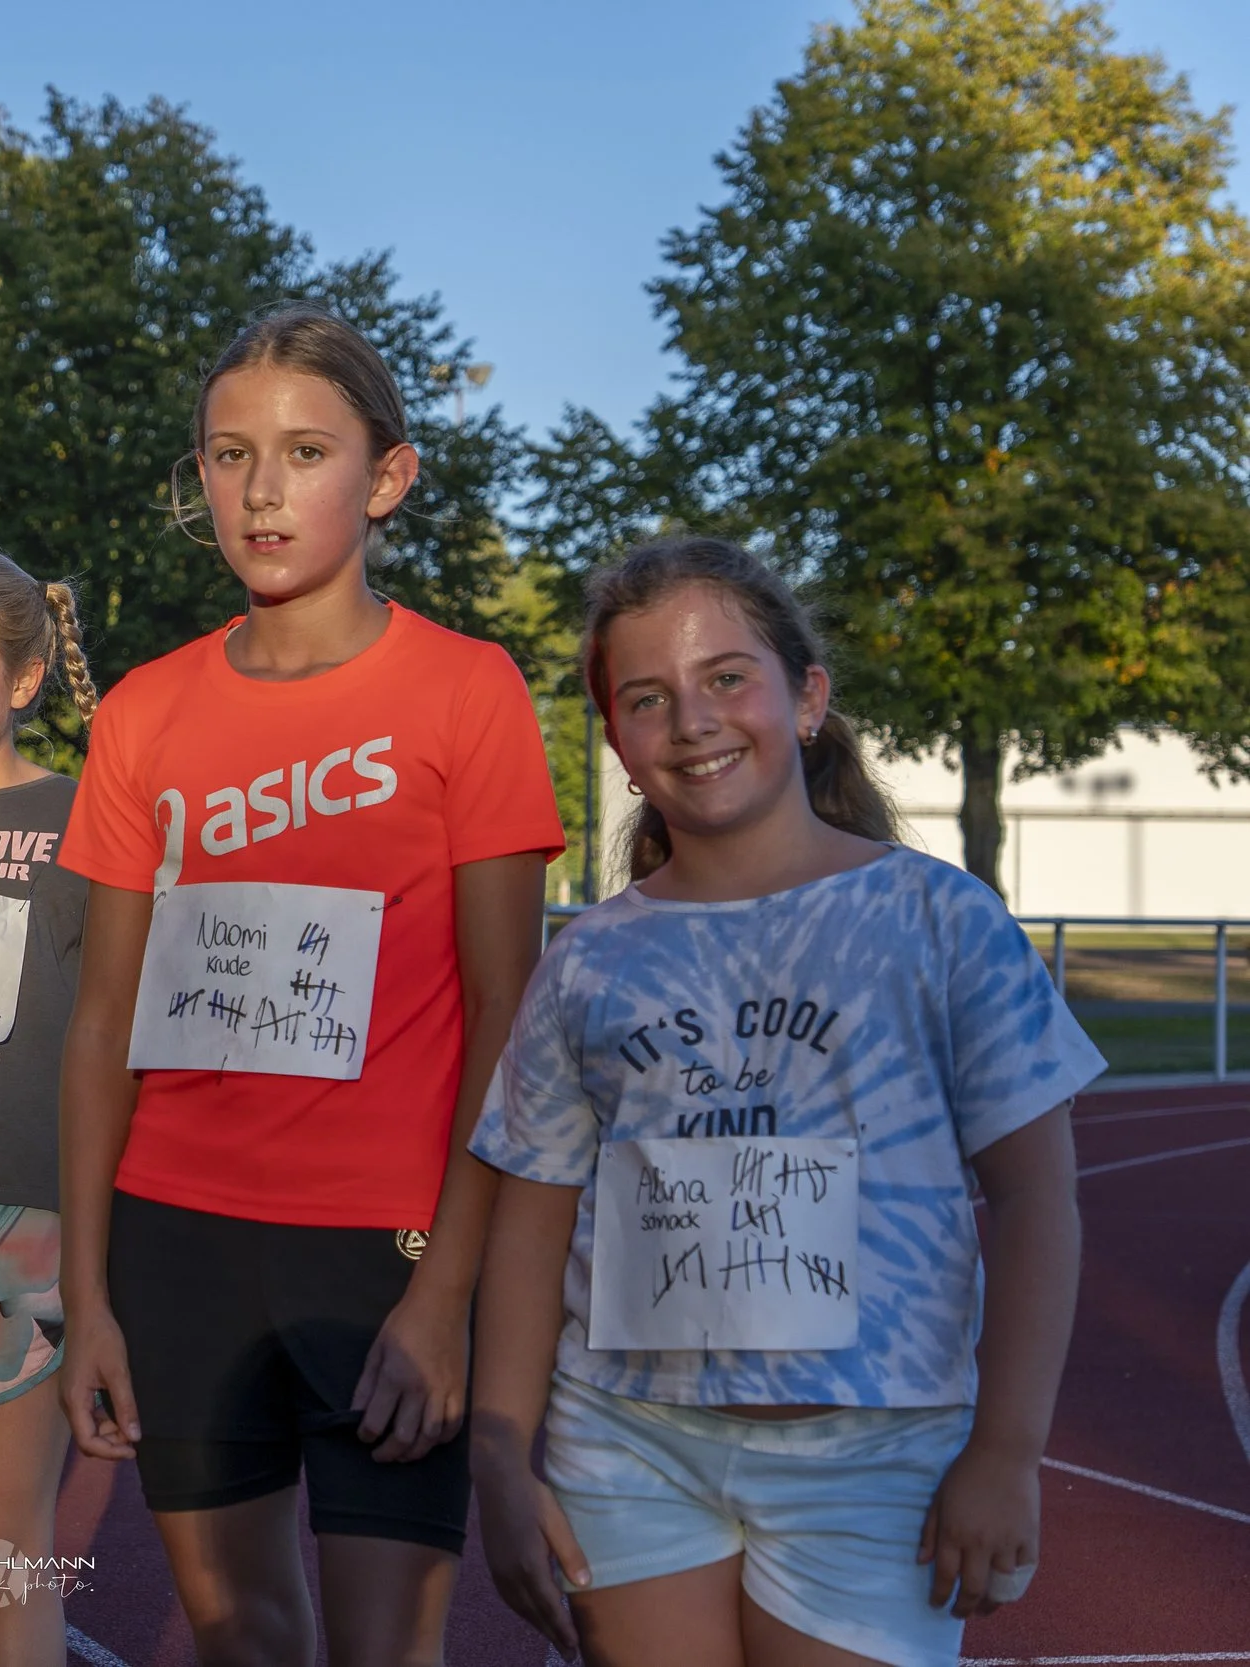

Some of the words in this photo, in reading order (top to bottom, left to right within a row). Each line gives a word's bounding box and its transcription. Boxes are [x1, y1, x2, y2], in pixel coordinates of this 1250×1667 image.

[197, 912, 267, 950] Naomi
[619, 1008, 704, 1074] IT'S
[736, 998, 840, 1055] COOL
[680, 1060, 722, 1095] to
[735, 1057, 776, 1092] be
[636, 1166, 713, 1206] Alina
